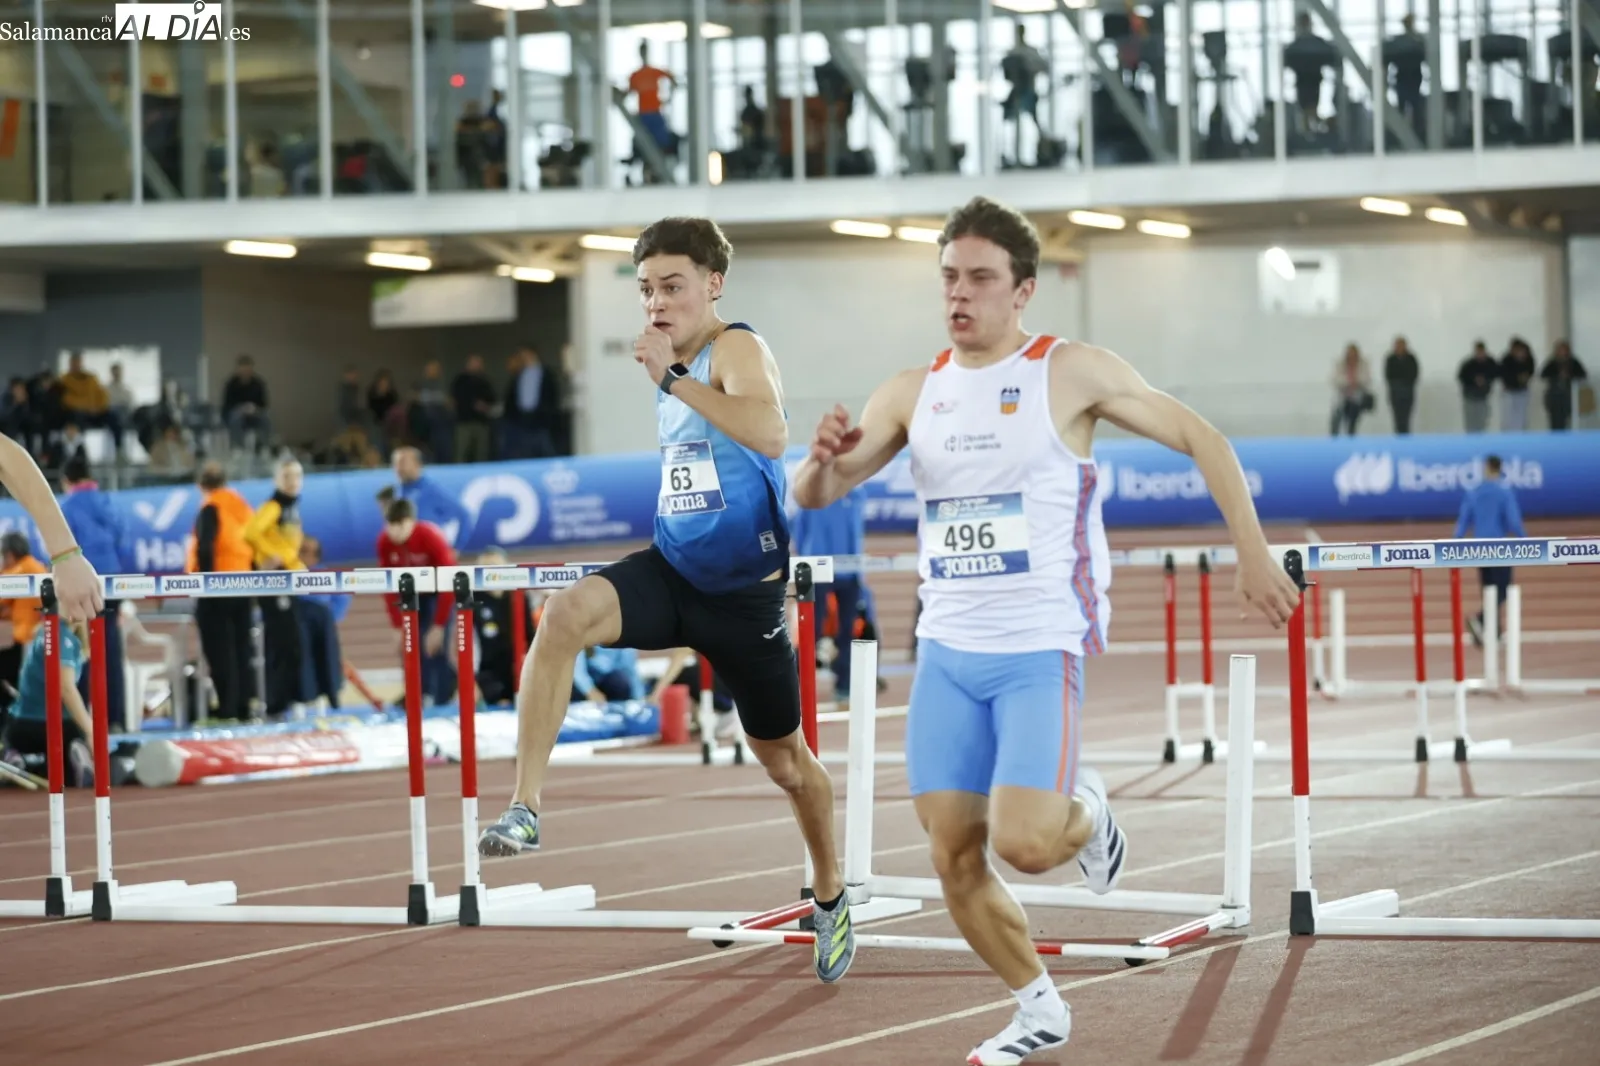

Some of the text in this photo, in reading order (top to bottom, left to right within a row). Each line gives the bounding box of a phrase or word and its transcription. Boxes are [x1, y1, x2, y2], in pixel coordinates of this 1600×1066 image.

[670, 466, 693, 491] 63
[944, 522, 996, 551] 496
[1442, 546, 1512, 560] SALAMANCA
[1515, 544, 1541, 558] 2025
[208, 576, 264, 589] SALAMANCA
[266, 575, 287, 588] 2025
